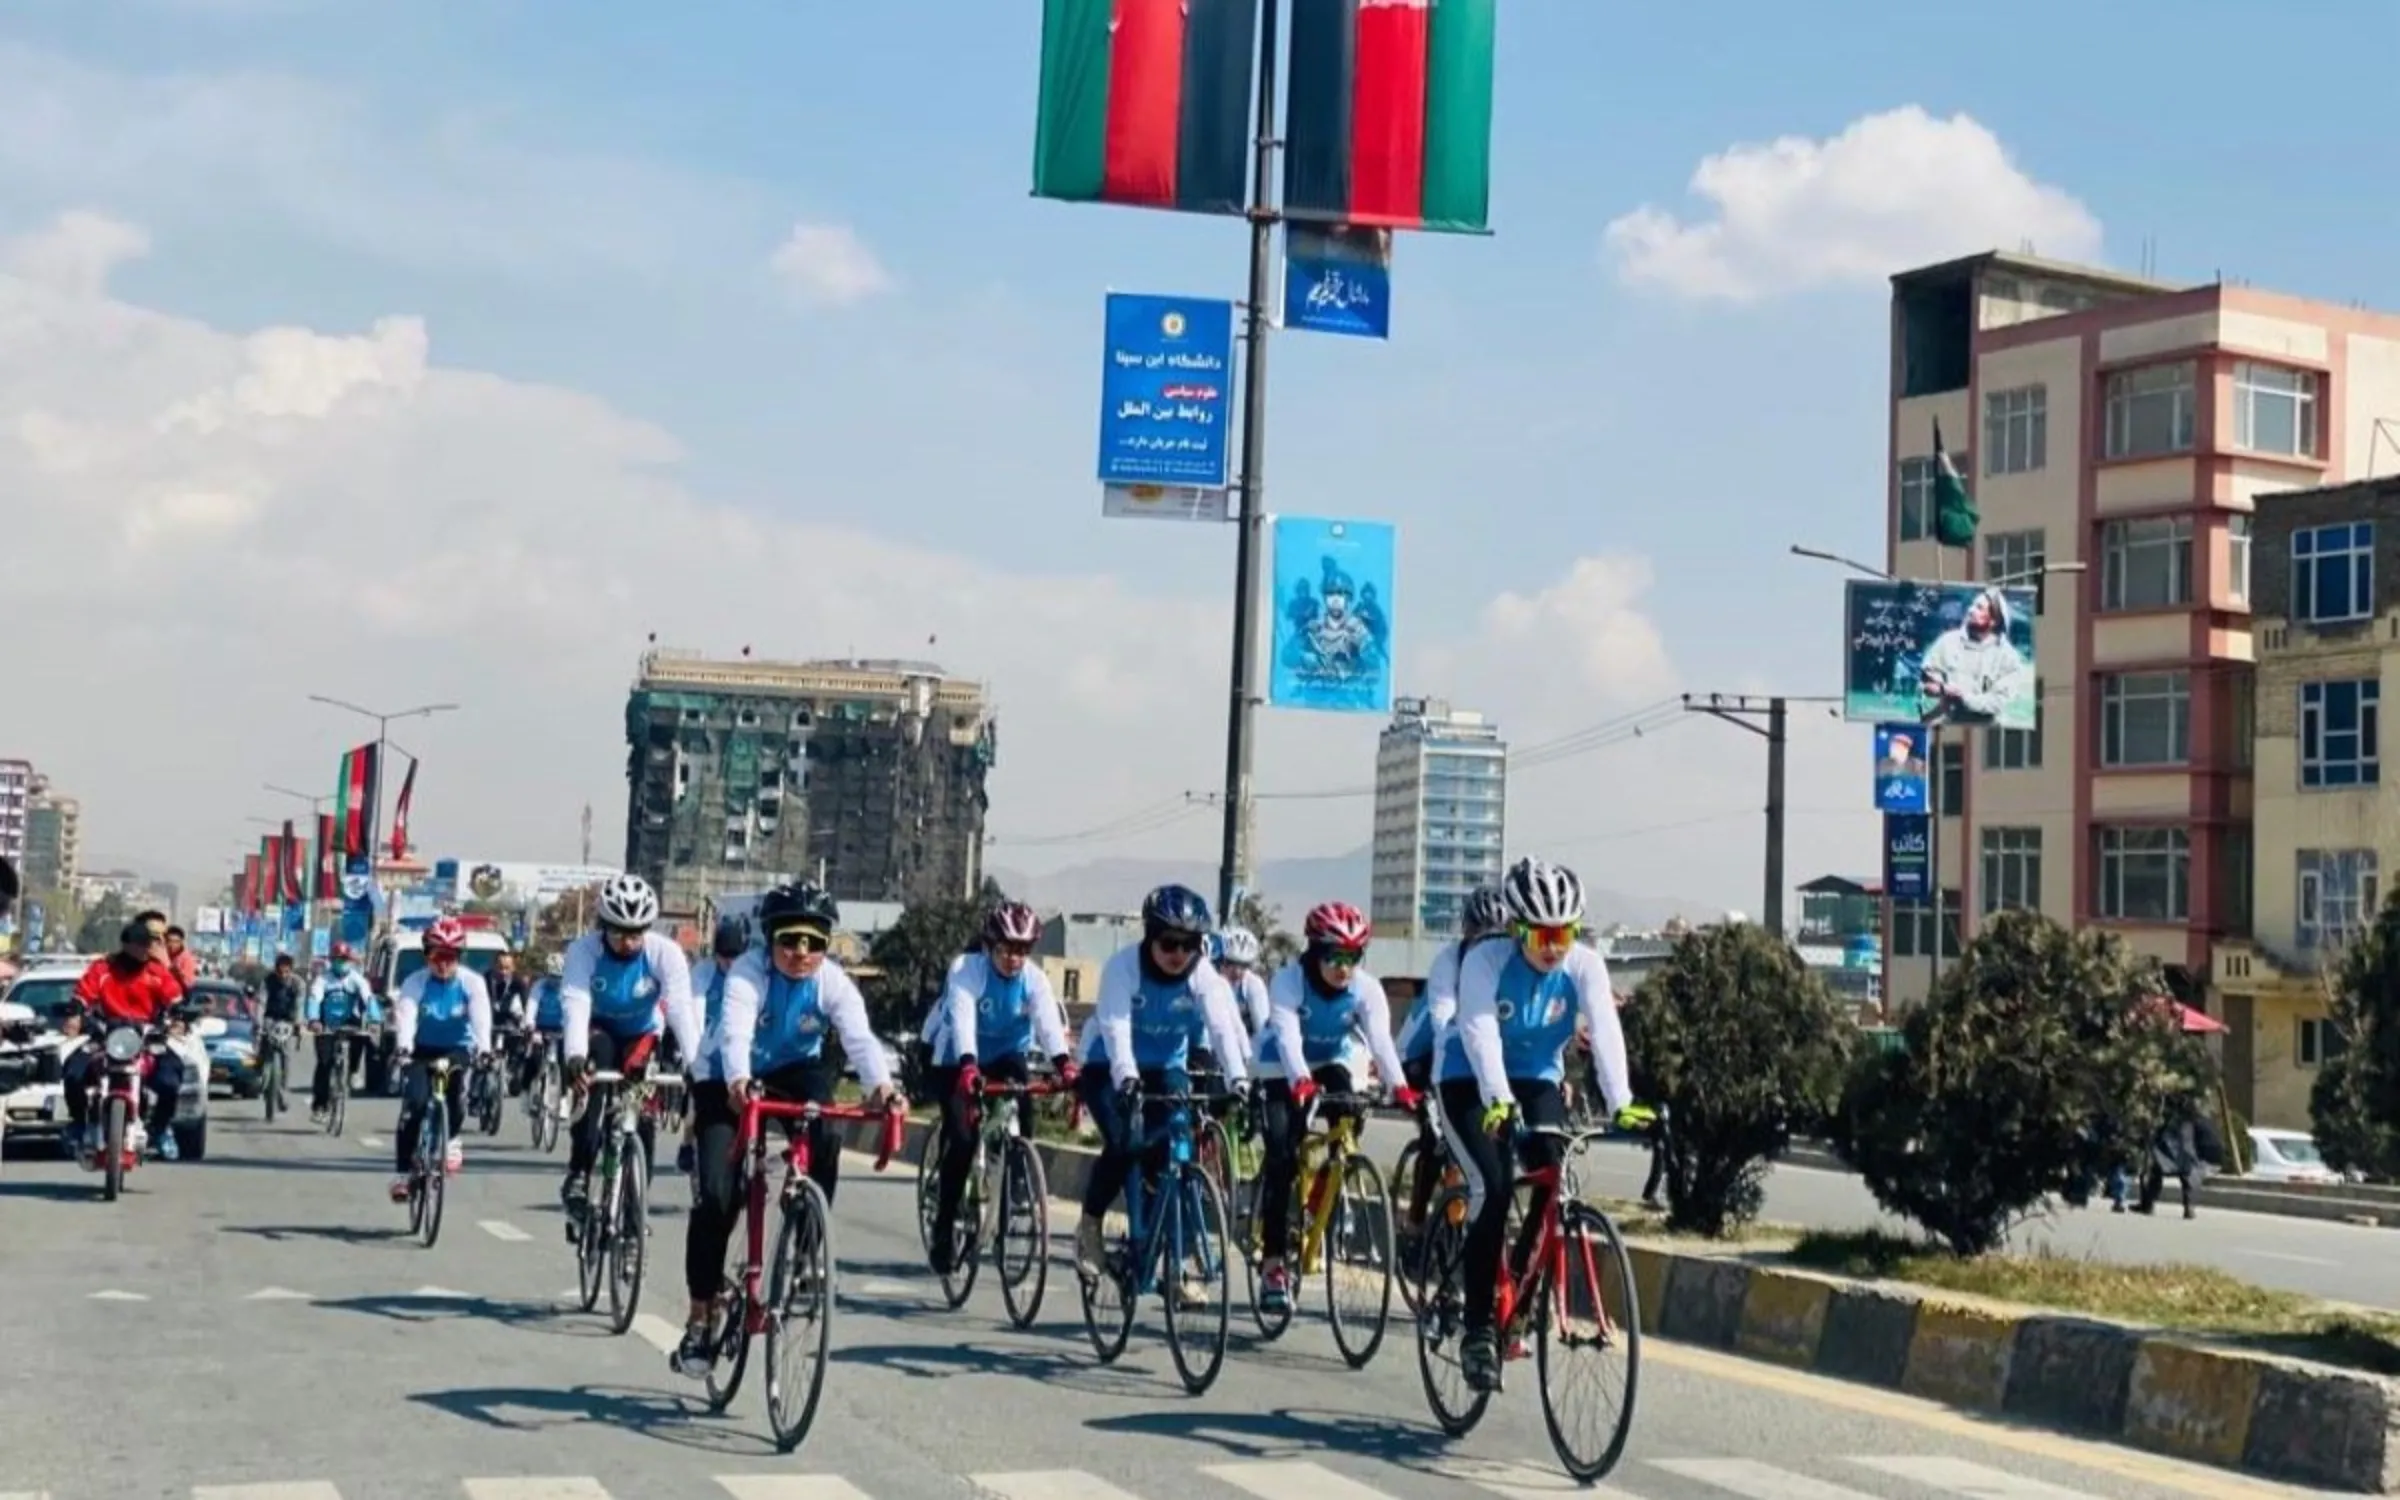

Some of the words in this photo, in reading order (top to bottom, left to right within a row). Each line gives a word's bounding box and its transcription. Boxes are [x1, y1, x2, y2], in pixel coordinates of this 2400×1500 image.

[1115, 349, 1143, 368] سینا
[1145, 351, 1165, 369] ابن
[1167, 352, 1221, 370] دانشگاه
[1116, 400, 1151, 419] الملل
[1152, 406, 1175, 421] بین
[1176, 402, 1214, 425] روابط
